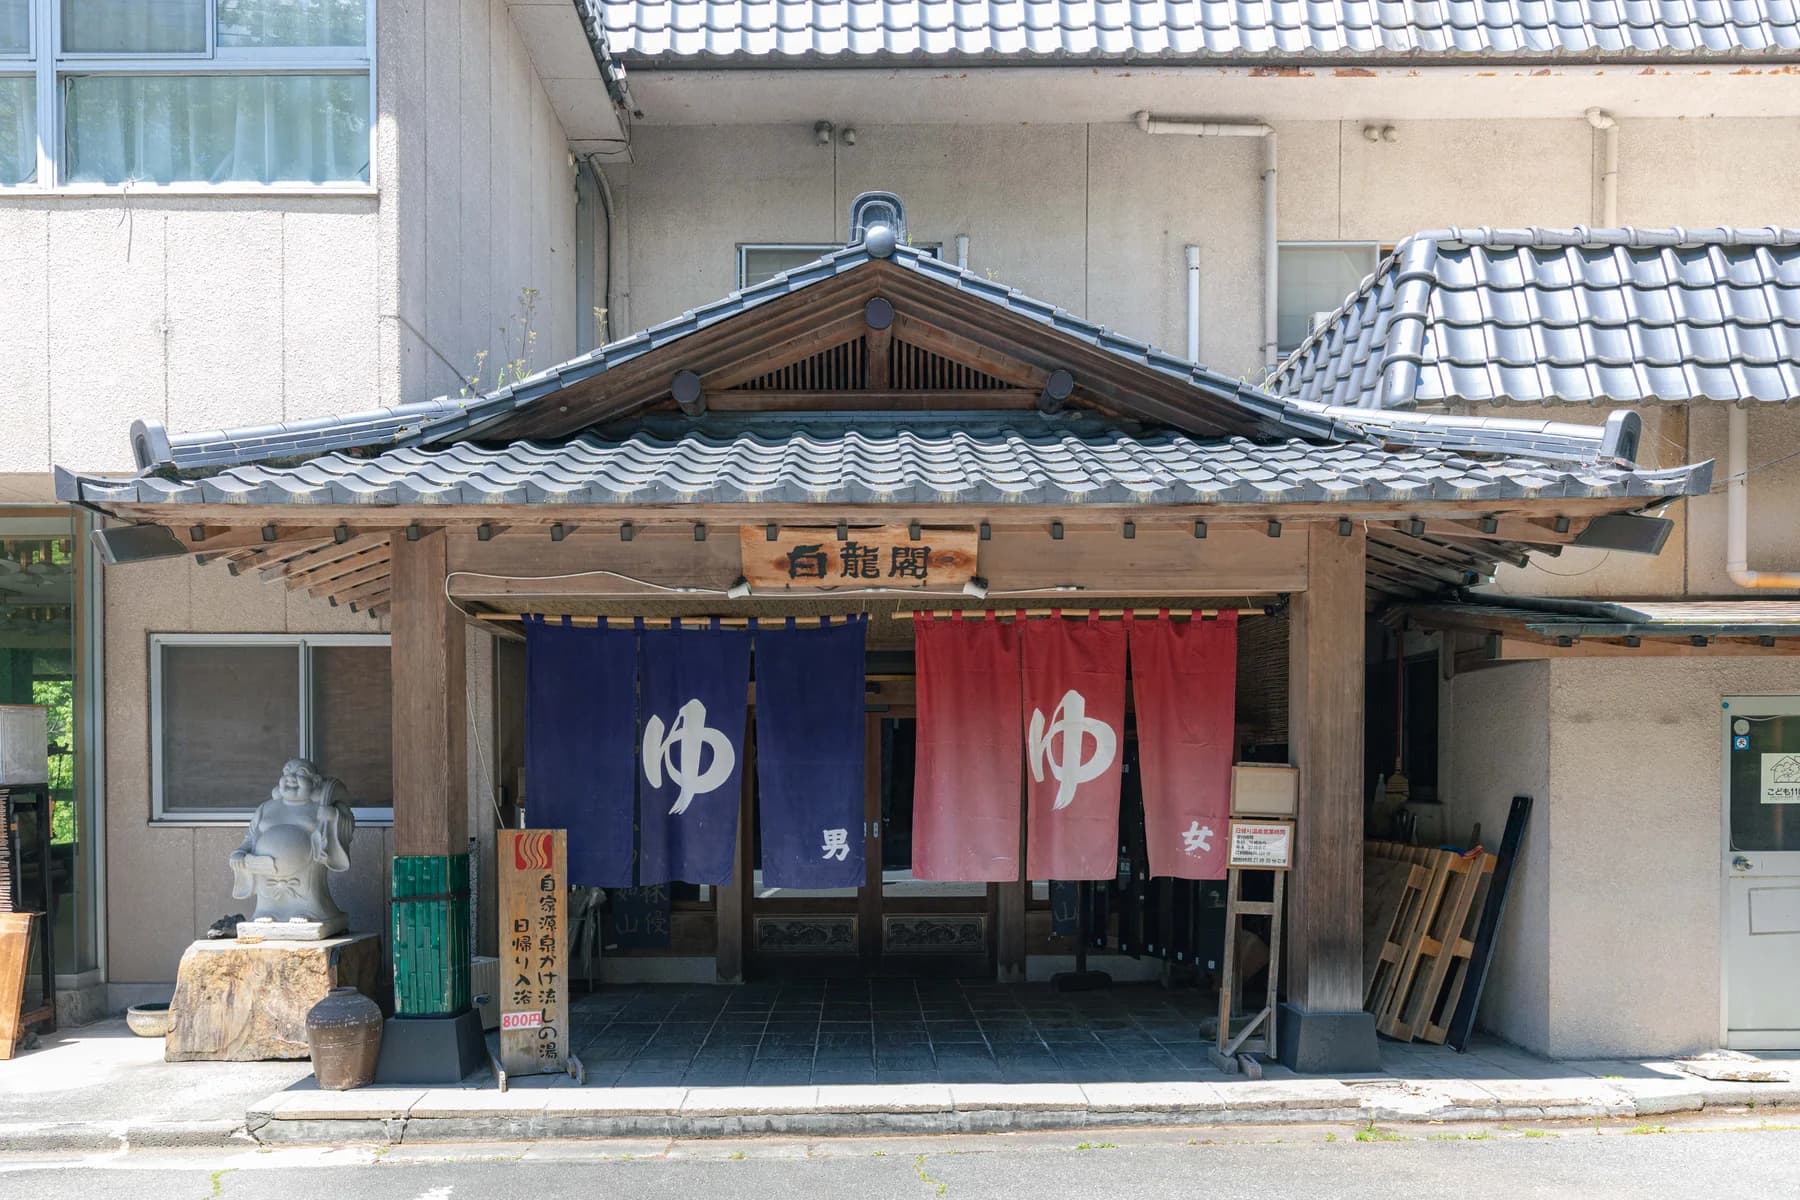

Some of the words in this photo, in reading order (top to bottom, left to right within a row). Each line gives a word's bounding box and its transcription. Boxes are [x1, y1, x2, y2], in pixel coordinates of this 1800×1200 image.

[787, 541, 932, 579] 白龍閣
[642, 698, 735, 815] ゆ
[1028, 689, 1117, 810] ゆ
[822, 828, 850, 861] 男
[1182, 821, 1214, 852] 女
[512, 918, 533, 1005] 日帰り入浴
[538, 874, 558, 1059] 自家源泉かけ流しの湯
[502, 1013, 542, 1028] 800円
